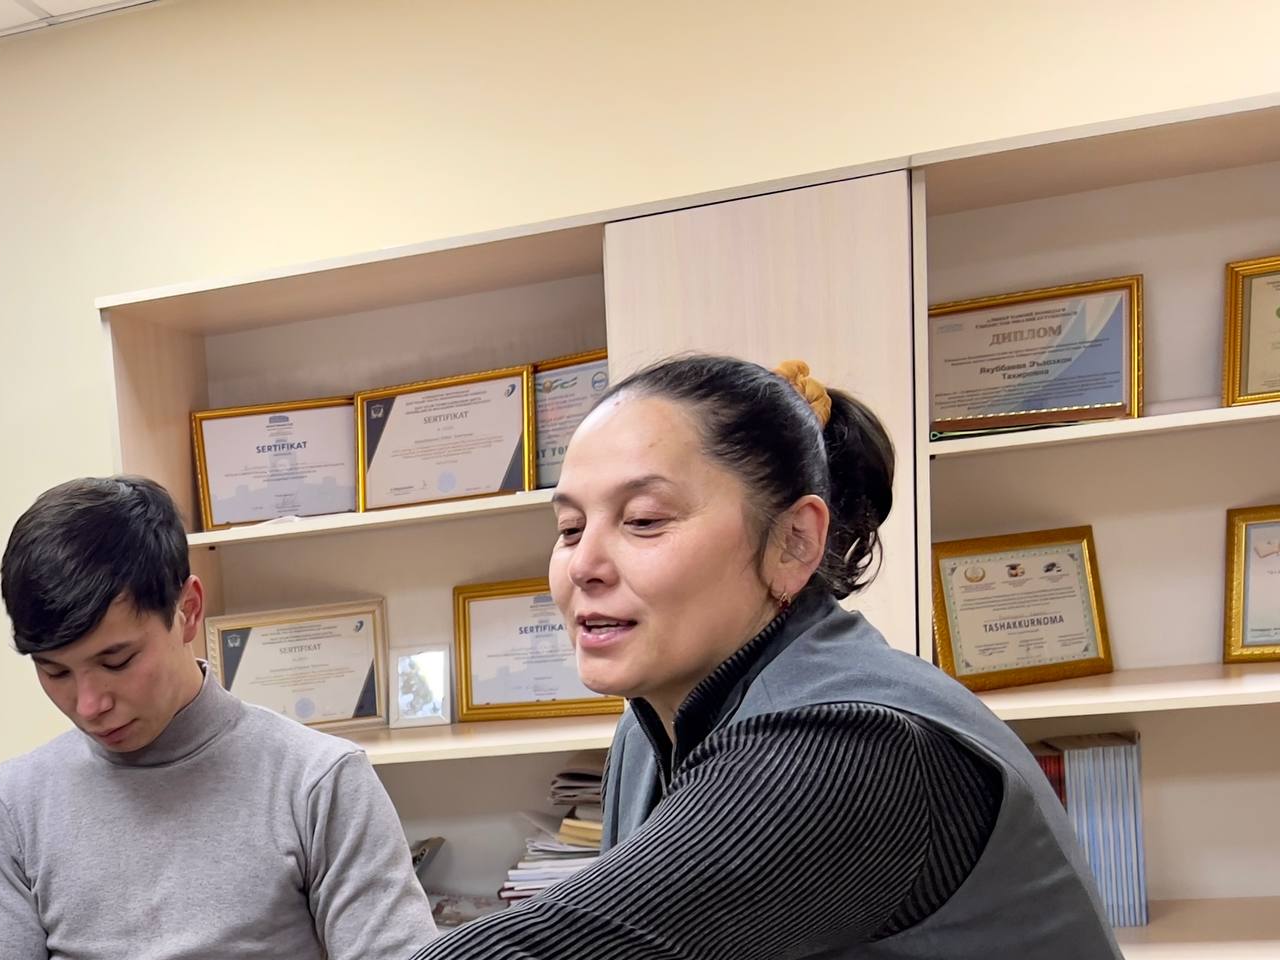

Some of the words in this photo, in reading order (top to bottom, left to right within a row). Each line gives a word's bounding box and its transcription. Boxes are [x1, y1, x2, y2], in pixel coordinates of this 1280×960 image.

[989, 325, 1062, 346] ДИПЛОМ
[423, 411, 468, 424] SERTIFIKAT
[256, 441, 307, 454] SERTIFIKAT
[519, 623, 567, 635] SERTIFIKA
[983, 615, 1064, 633] TASHAKKURNOMA
[279, 643, 321, 655] SERTIFIKAT
